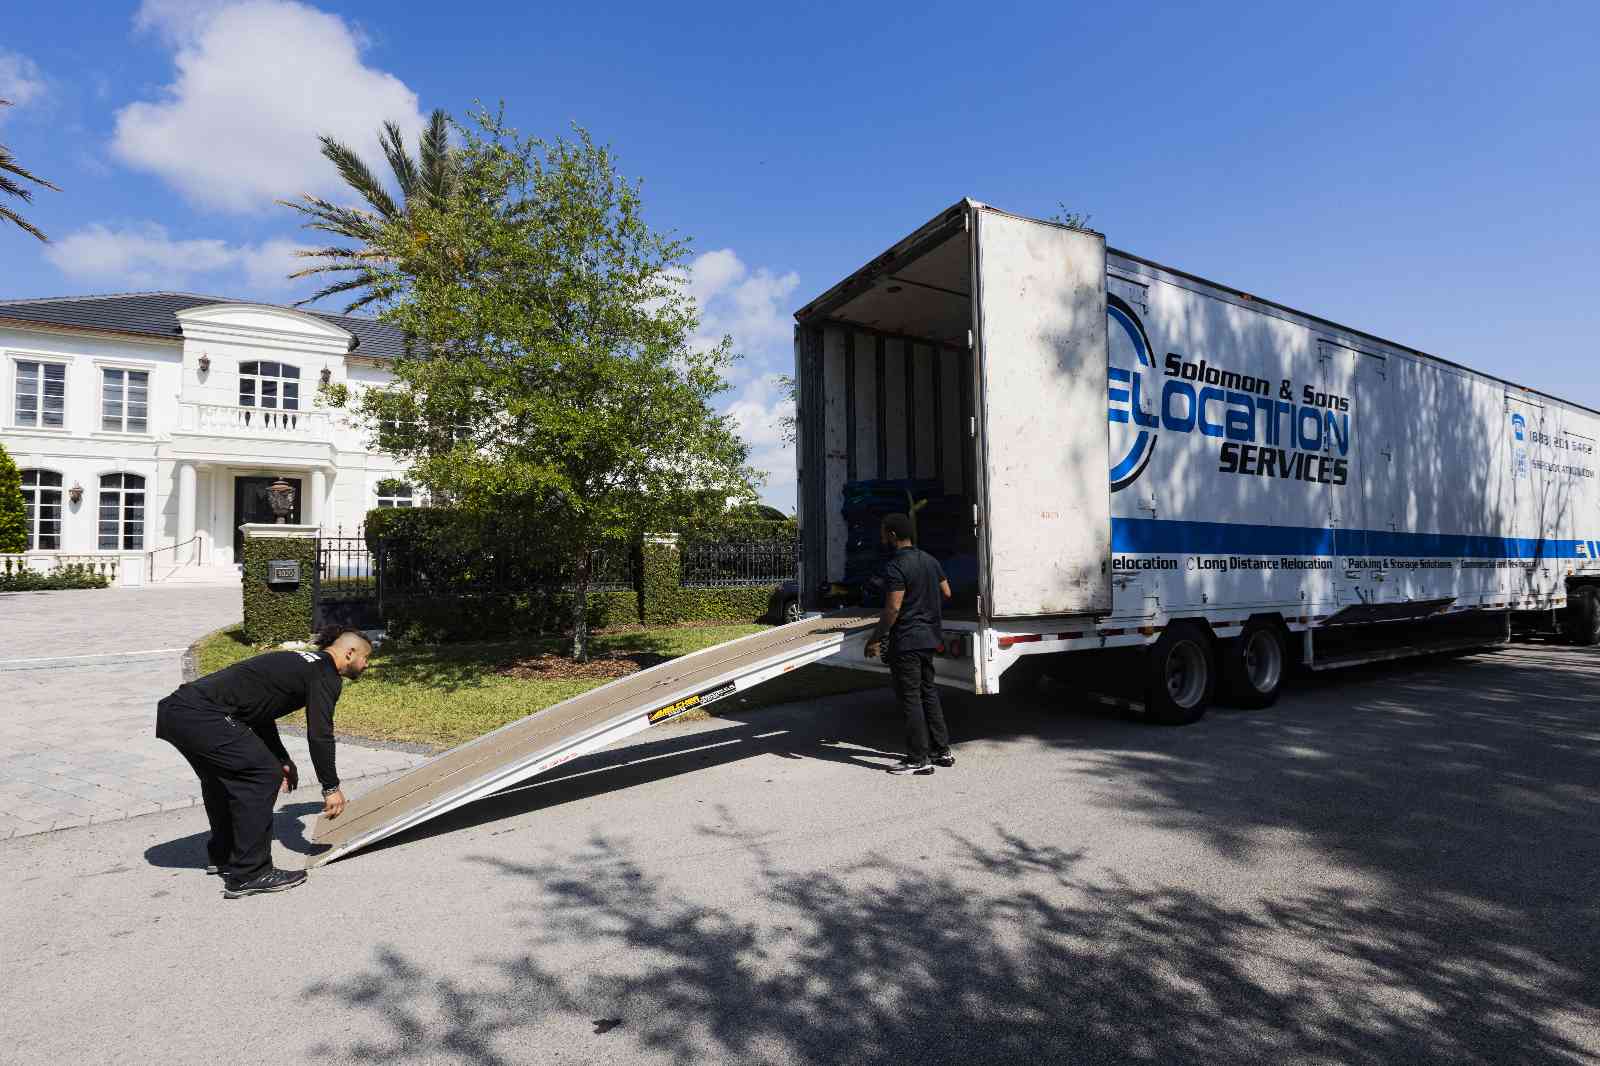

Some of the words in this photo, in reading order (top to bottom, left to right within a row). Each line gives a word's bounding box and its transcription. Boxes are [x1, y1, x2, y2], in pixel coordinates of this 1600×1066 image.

[1164, 352, 1270, 396] Solomon
[1279, 379, 1293, 401] &
[1301, 384, 1349, 412] Sons
[1218, 441, 1348, 486] SERVICES
[1112, 556, 1178, 570] elocation
[1197, 557, 1227, 573] Long
[1230, 556, 1279, 570] Distance
[1281, 557, 1333, 570] Relocation
[1348, 558, 1382, 571] Packing
[1419, 558, 1452, 569] Solutis
